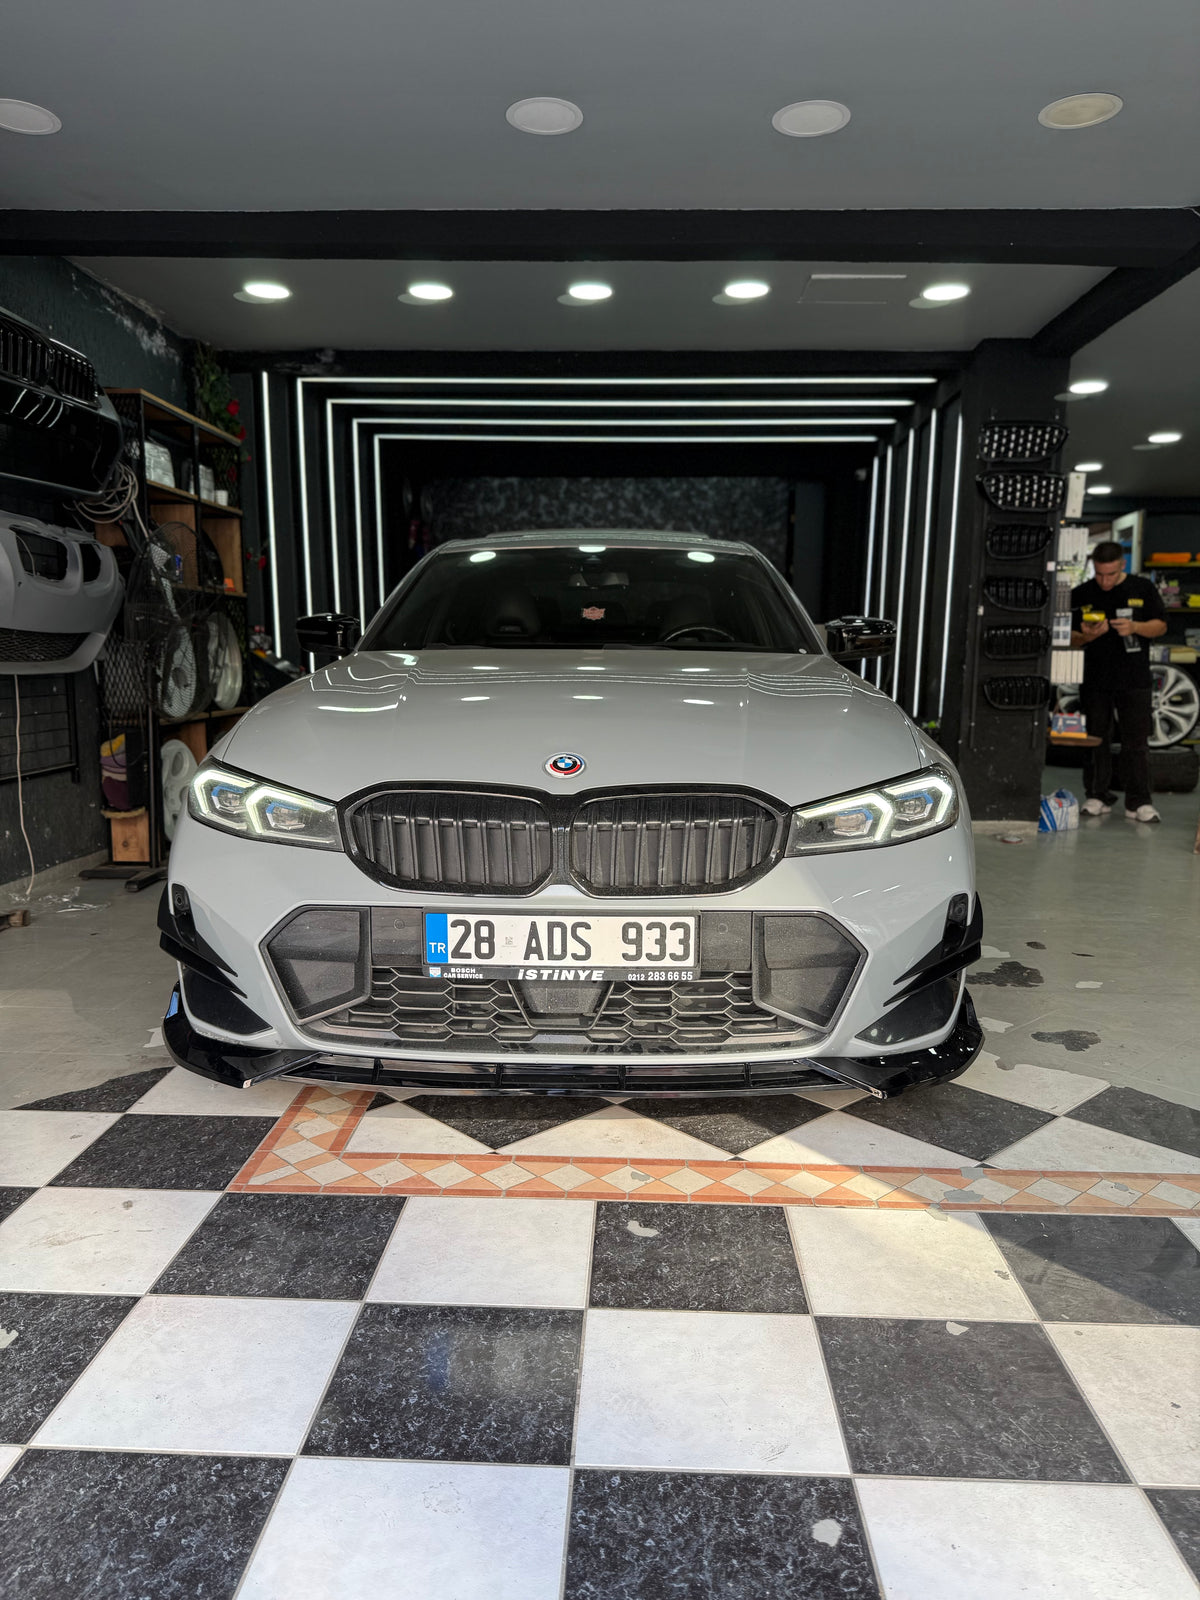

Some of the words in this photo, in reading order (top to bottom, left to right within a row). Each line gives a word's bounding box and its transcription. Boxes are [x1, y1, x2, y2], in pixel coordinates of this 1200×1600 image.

[450, 919, 496, 960] 28
[523, 921, 592, 961] ADS
[621, 921, 691, 962] 933
[429, 942, 446, 954] TR
[627, 973, 646, 981] 0212
[647, 971, 666, 981] 283
[667, 971, 680, 981] 66
[681, 971, 693, 981] 55
